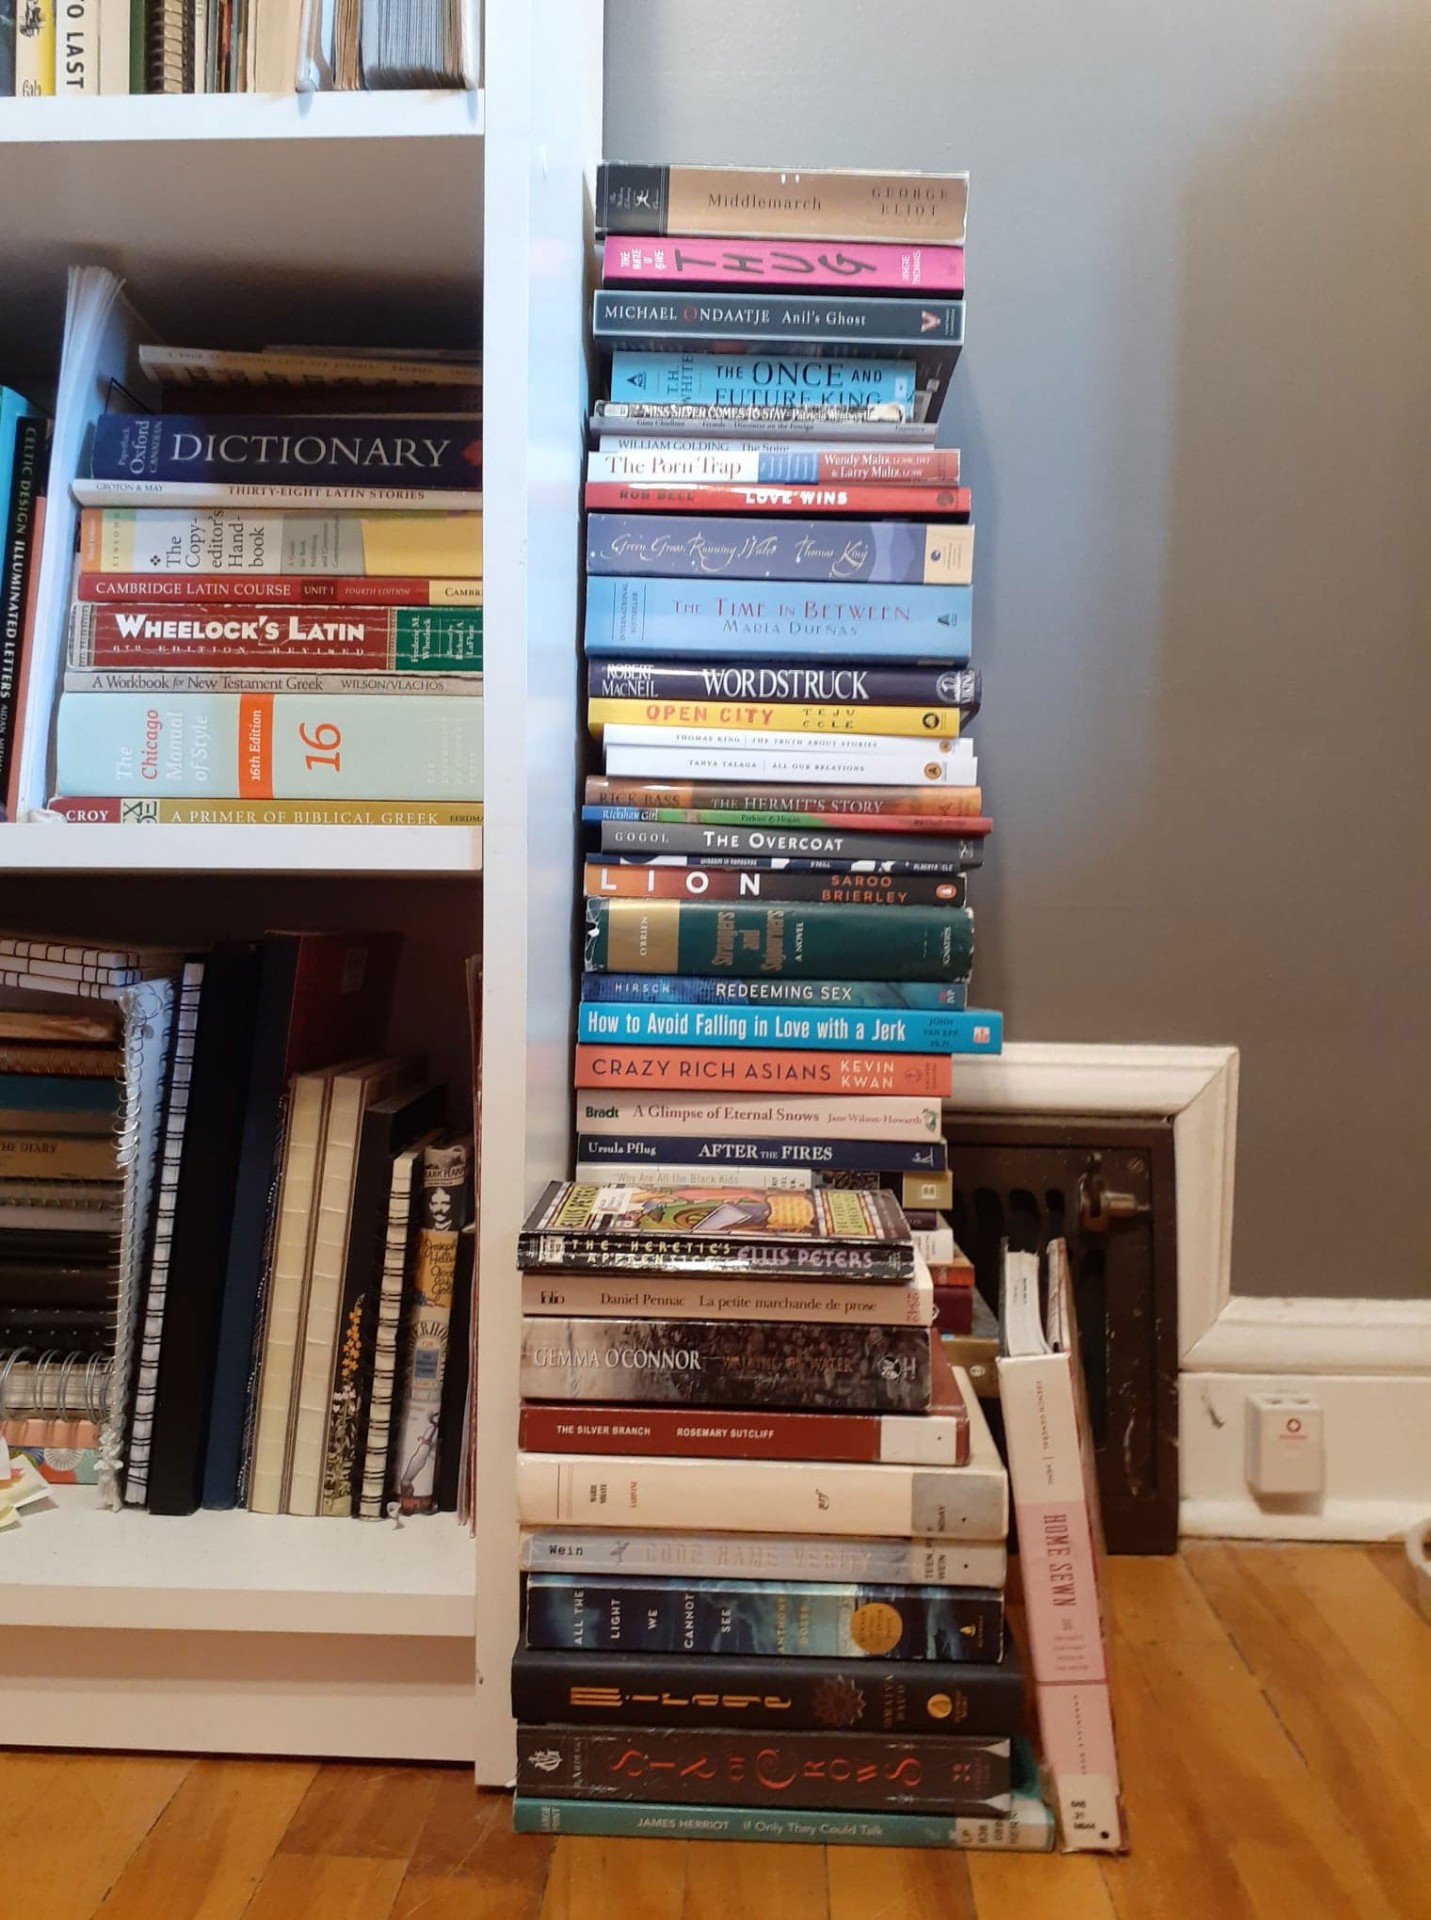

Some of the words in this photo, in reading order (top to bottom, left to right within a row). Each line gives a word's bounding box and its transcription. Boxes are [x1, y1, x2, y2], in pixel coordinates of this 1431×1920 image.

[66, 31, 85, 89] LAST
[707, 192, 822, 212] Middlemarch
[871, 185, 951, 202] GEORGE
[880, 204, 938, 217] ELIOT
[674, 247, 878, 276] THUG
[603, 304, 678, 321] MICHAEL
[681, 307, 771, 325] ONDAATJE
[781, 309, 820, 325] Anil's
[825, 310, 867, 327] Ghost
[715, 364, 744, 380] THE
[752, 360, 844, 388] ONCE
[851, 368, 883, 384] AND
[642, 404, 671, 419] MISS
[671, 403, 707, 419] SILVER
[707, 404, 746, 420] COMES
[747, 405, 761, 420] TO
[761, 406, 787, 421] STAY
[22, 426, 37, 477] CELTIC
[129, 420, 150, 475] Oxford
[169, 433, 451, 469] DICTIONARY
[618, 439, 671, 451] WILLIAM
[673, 439, 730, 452] GOLDING
[604, 456, 645, 475] The
[652, 456, 693, 475] Porn
[697, 456, 742, 480] Trap
[824, 453, 860, 468] Wendy
[862, 453, 889, 467] Maltz
[229, 485, 321, 498] THIRTY-EIGHT
[326, 487, 365, 499] LATIN
[369, 488, 426, 500] STORIES
[745, 488, 792, 505] LOVE
[800, 490, 848, 506] WINS
[16, 478, 33, 536] DESIGN
[184, 517, 206, 569] Copy-
[207, 509, 225, 569] editor's
[227, 515, 245, 569] Hand-
[248, 526, 265, 569] book
[165, 535, 183, 569] The
[8, 538, 27, 641] ILLUMINATED
[95, 582, 182, 596] CAMBRIDGE
[186, 583, 230, 596] LATIN
[233, 584, 292, 597] COURSE
[303, 585, 329, 596] UNIT
[344, 586, 377, 596] FOURTH
[377, 587, 411, 597] EDITION
[673, 599, 701, 615] THE
[716, 597, 765, 617] TIME
[779, 601, 796, 617] IN
[803, 599, 911, 622] BETWEEN
[114, 612, 280, 641] WHEELOCK'S
[287, 615, 365, 642] LATIN
[1, 640, 17, 700] LETTERS
[92, 675, 103, 688] A
[106, 674, 170, 690] Workbook
[172, 676, 185, 690] for
[187, 676, 218, 690] New
[221, 676, 283, 692] Testament
[285, 676, 324, 692] Greek
[341, 679, 445, 692] WILSON/VLACHOS
[702, 667, 870, 700] WORDSTRUCK
[645, 704, 708, 722] OPEN
[719, 707, 775, 726] CITY
[803, 707, 856, 717] TEJU
[248, 708, 263, 747] Edition
[802, 719, 856, 729] COLE
[141, 708, 163, 780] Chicago
[190, 712, 212, 759] Style
[676, 733, 713, 743] THOMAS
[717, 734, 741, 744] KING
[752, 736, 769, 745] THE
[773, 737, 803, 746] TRUTH
[807, 738, 838, 748] ABOUT
[841, 739, 878, 749] STORIES
[166, 711, 184, 781] Manual
[297, 721, 342, 774] 16
[115, 746, 133, 780] The
[190, 762, 212, 782] of
[248, 748, 262, 782] 16th
[689, 758, 718, 768] TANYA
[722, 760, 758, 769] TALAGA
[771, 762, 789, 770] ALL
[792, 763, 811, 771] OUR
[814, 764, 865, 773] RELATIONS
[711, 797, 738, 810] THE
[743, 796, 826, 814] HERMIT'S
[831, 799, 884, 814] STORY
[65, 809, 110, 822] CROY
[171, 810, 182, 823] A
[190, 810, 257, 824] PRIMER
[263, 811, 287, 824] OF
[293, 811, 375, 825] BIBLICAL
[380, 812, 439, 825] GREEK
[614, 831, 670, 844] GOGOL
[702, 830, 740, 848] THE
[749, 832, 845, 852] OVERCOAT
[600, 867, 762, 896] LION
[830, 875, 893, 888] SAROO
[821, 889, 909, 904] BRIERLEY
[614, 981, 671, 994] HIRSCH
[715, 983, 814, 1001] REDEEMING
[820, 985, 852, 1001] SEX
[588, 1010, 620, 1034] How
[625, 1011, 640, 1034] to
[647, 1011, 688, 1036] Avoid
[695, 1013, 747, 1040] Falling
[754, 1015, 768, 1038] in
[775, 1015, 810, 1040] Love
[816, 1016, 849, 1041] with
[855, 1023, 865, 1041] a
[871, 1018, 906, 1042] Jerk
[592, 1059, 671, 1077] CRAZY
[679, 1060, 736, 1079] RICH
[744, 1063, 832, 1082] ASIANS
[840, 1060, 895, 1074] KEVIN
[841, 1076, 894, 1090] KWAN
[585, 1105, 620, 1119] Bradt
[633, 1105, 644, 1118] A
[648, 1104, 704, 1122] Glimpse
[707, 1107, 721, 1120] of
[724, 1107, 773, 1122] Eternal
[775, 1108, 820, 1123] Snows
[827, 1112, 847, 1124] Jane
[849, 1112, 923, 1126] Wilson-Howarth
[588, 1141, 625, 1155] Ursula
[626, 1142, 657, 1157] Pflug
[698, 1143, 758, 1160] AFTER
[760, 1151, 779, 1160] THE
[780, 1145, 833, 1161] FIRES
[736, 1244, 790, 1267] ELLIS
[797, 1247, 873, 1270] PETERS
[600, 1291, 640, 1306] Daniel
[643, 1293, 685, 1306] Pennac
[699, 1294, 715, 1307] La
[717, 1296, 751, 1312] petite
[754, 1297, 822, 1312] marchande
[825, 1297, 841, 1311] de
[844, 1301, 877, 1316] prose
[534, 1347, 601, 1369] GEMMA
[604, 1347, 702, 1371] O'CONNOR
[556, 1424, 574, 1435] THE
[577, 1425, 610, 1436] SILVER
[612, 1425, 651, 1437] BRANCH
[677, 1427, 728, 1439] ROSEMARY
[730, 1428, 775, 1440] SUTCLIFF
[1042, 1513, 1071, 1558] HOME
[549, 1544, 584, 1557] Wein
[1048, 1561, 1077, 1607] SEWN
[573, 1589, 586, 1614] THE
[610, 1598, 622, 1640] LIGHT
[647, 1608, 659, 1630] WE
[683, 1592, 696, 1650] CANNOT
[720, 1608, 732, 1634] SEE
[573, 1614, 585, 1646] ALL
[636, 1817, 677, 1830] JAMES
[679, 1818, 730, 1831] HERRIOT
[754, 1820, 783, 1836] Only
[788, 1821, 817, 1838] They
[819, 1823, 858, 1836] Could
[862, 1824, 884, 1837] Talk
